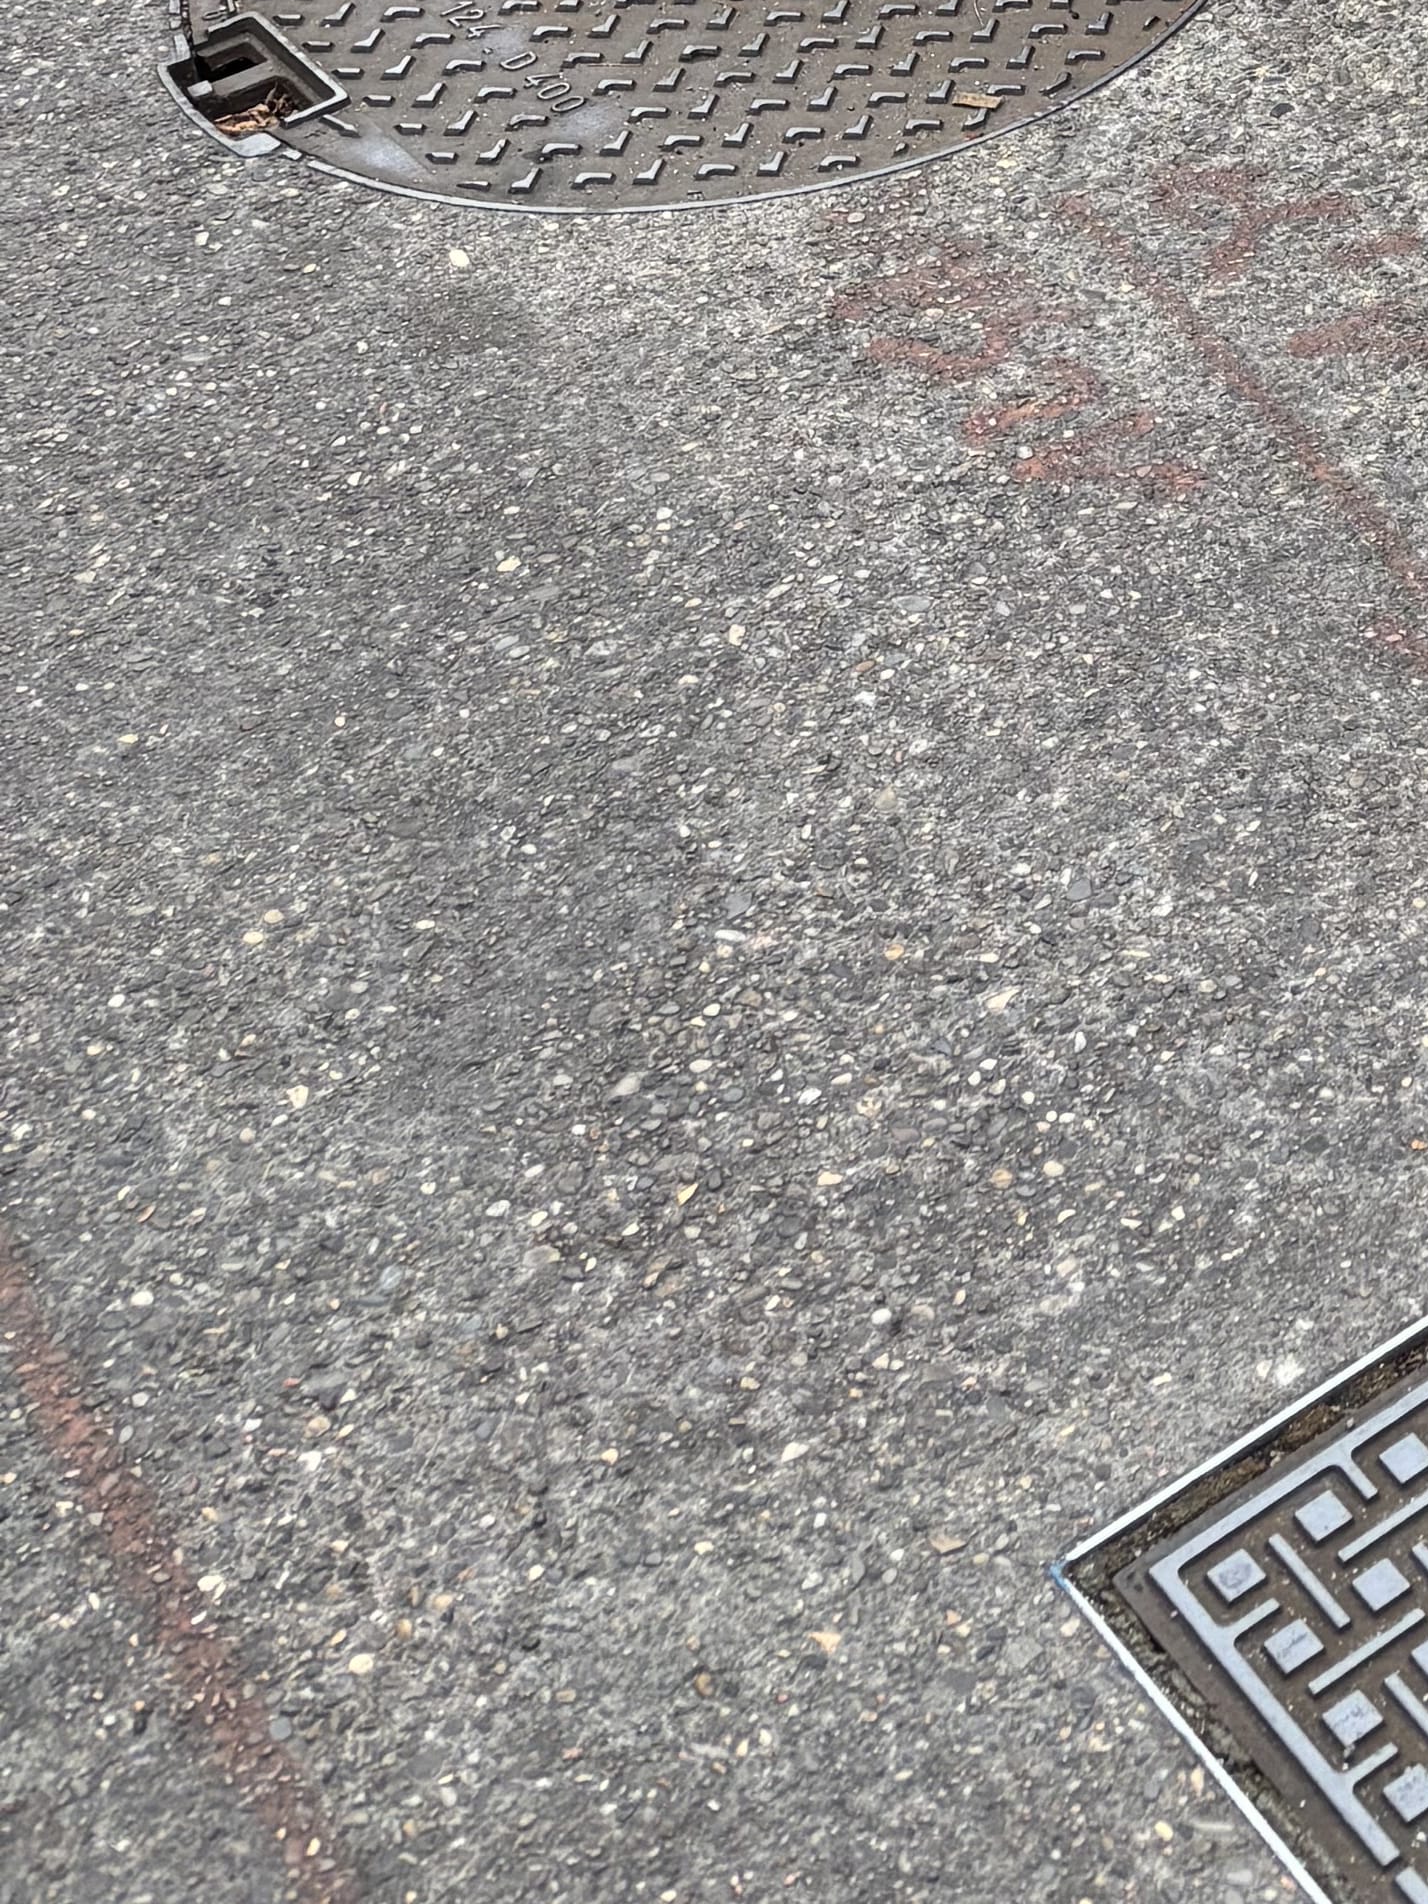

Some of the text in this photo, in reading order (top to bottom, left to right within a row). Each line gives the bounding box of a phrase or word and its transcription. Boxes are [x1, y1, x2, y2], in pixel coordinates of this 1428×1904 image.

[439, 0, 503, 40] 124
[500, 50, 538, 72] D
[523, 72, 586, 113] 400
